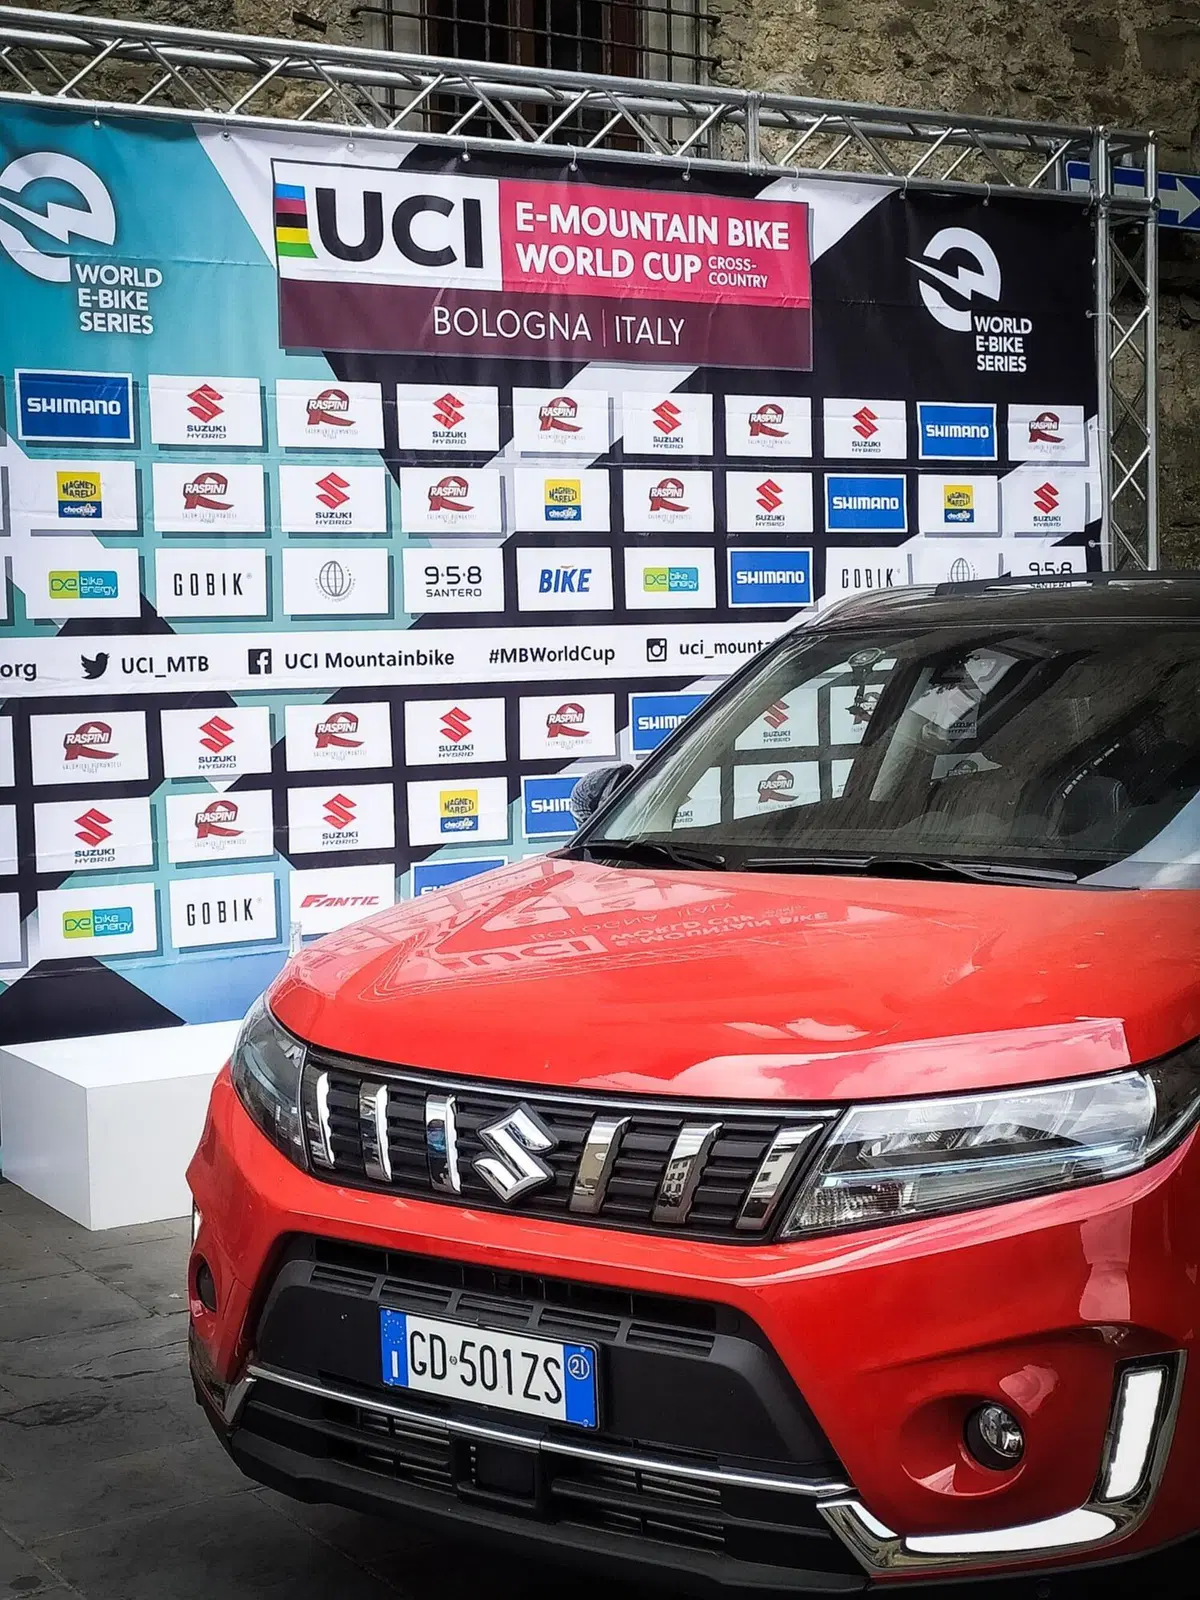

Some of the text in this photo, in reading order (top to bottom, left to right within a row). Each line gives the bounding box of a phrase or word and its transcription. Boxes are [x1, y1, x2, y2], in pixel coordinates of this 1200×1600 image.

[315, 186, 485, 269] UCI
[515, 200, 791, 253] E-MOUNTAIN BIKE
[515, 242, 703, 286] WORLD CUP
[707, 254, 757, 273] CROSS-
[75, 263, 164, 290] WORLD
[707, 270, 769, 289] COUNTRY
[78, 288, 150, 312] E-BIKE
[79, 311, 155, 335] SERIES
[433, 306, 686, 347] BOLOGNA ITALY
[973, 315, 1034, 336] WORLD
[975, 335, 1025, 354] E-BIKE
[976, 353, 1028, 374] SERIES
[27, 397, 121, 416] SHIMANO
[308, 400, 348, 411] RASPINI
[540, 407, 577, 418] RASPINI
[750, 414, 783, 424] RASPINI
[186, 424, 227, 433] SUZUKI
[432, 431, 467, 439] SUZUKI
[926, 425, 990, 438] SHIMANO
[653, 436, 684, 444] SUZUKI
[184, 482, 227, 495] RASPINI
[430, 487, 467, 498] RASPINI
[650, 488, 683, 498] RASPINI
[832, 496, 899, 510] SHIMANO
[315, 511, 352, 519] SUZUKI
[80, 576, 104, 586] bike
[539, 568, 592, 593] BIKE
[736, 570, 806, 584] SHIMANO
[173, 572, 243, 596] GOBIK
[80, 585, 117, 597] energy
[425, 588, 482, 598] SANTERO
[285, 649, 455, 669] UCI Mountainbike
[489, 645, 616, 666] #MBWorldCup
[121, 655, 209, 678] UCI_MTB
[548, 713, 583, 724] RASPINI
[317, 722, 357, 734] RASPINI
[763, 730, 791, 738] SUZUKI
[66, 731, 110, 745] RASPINI
[438, 744, 474, 752] SUZUKI
[198, 755, 237, 763] SUZUKI
[760, 780, 793, 790] RASPINI
[197, 811, 236, 823] RASPINI
[322, 831, 359, 840] SUZUKI
[74, 848, 115, 858] SUZUKI
[301, 894, 380, 908] FANTIC
[94, 913, 119, 924] bike
[187, 898, 253, 927] GOBIK
[94, 921, 132, 933] energy
[571, 1358, 585, 1376] 21
